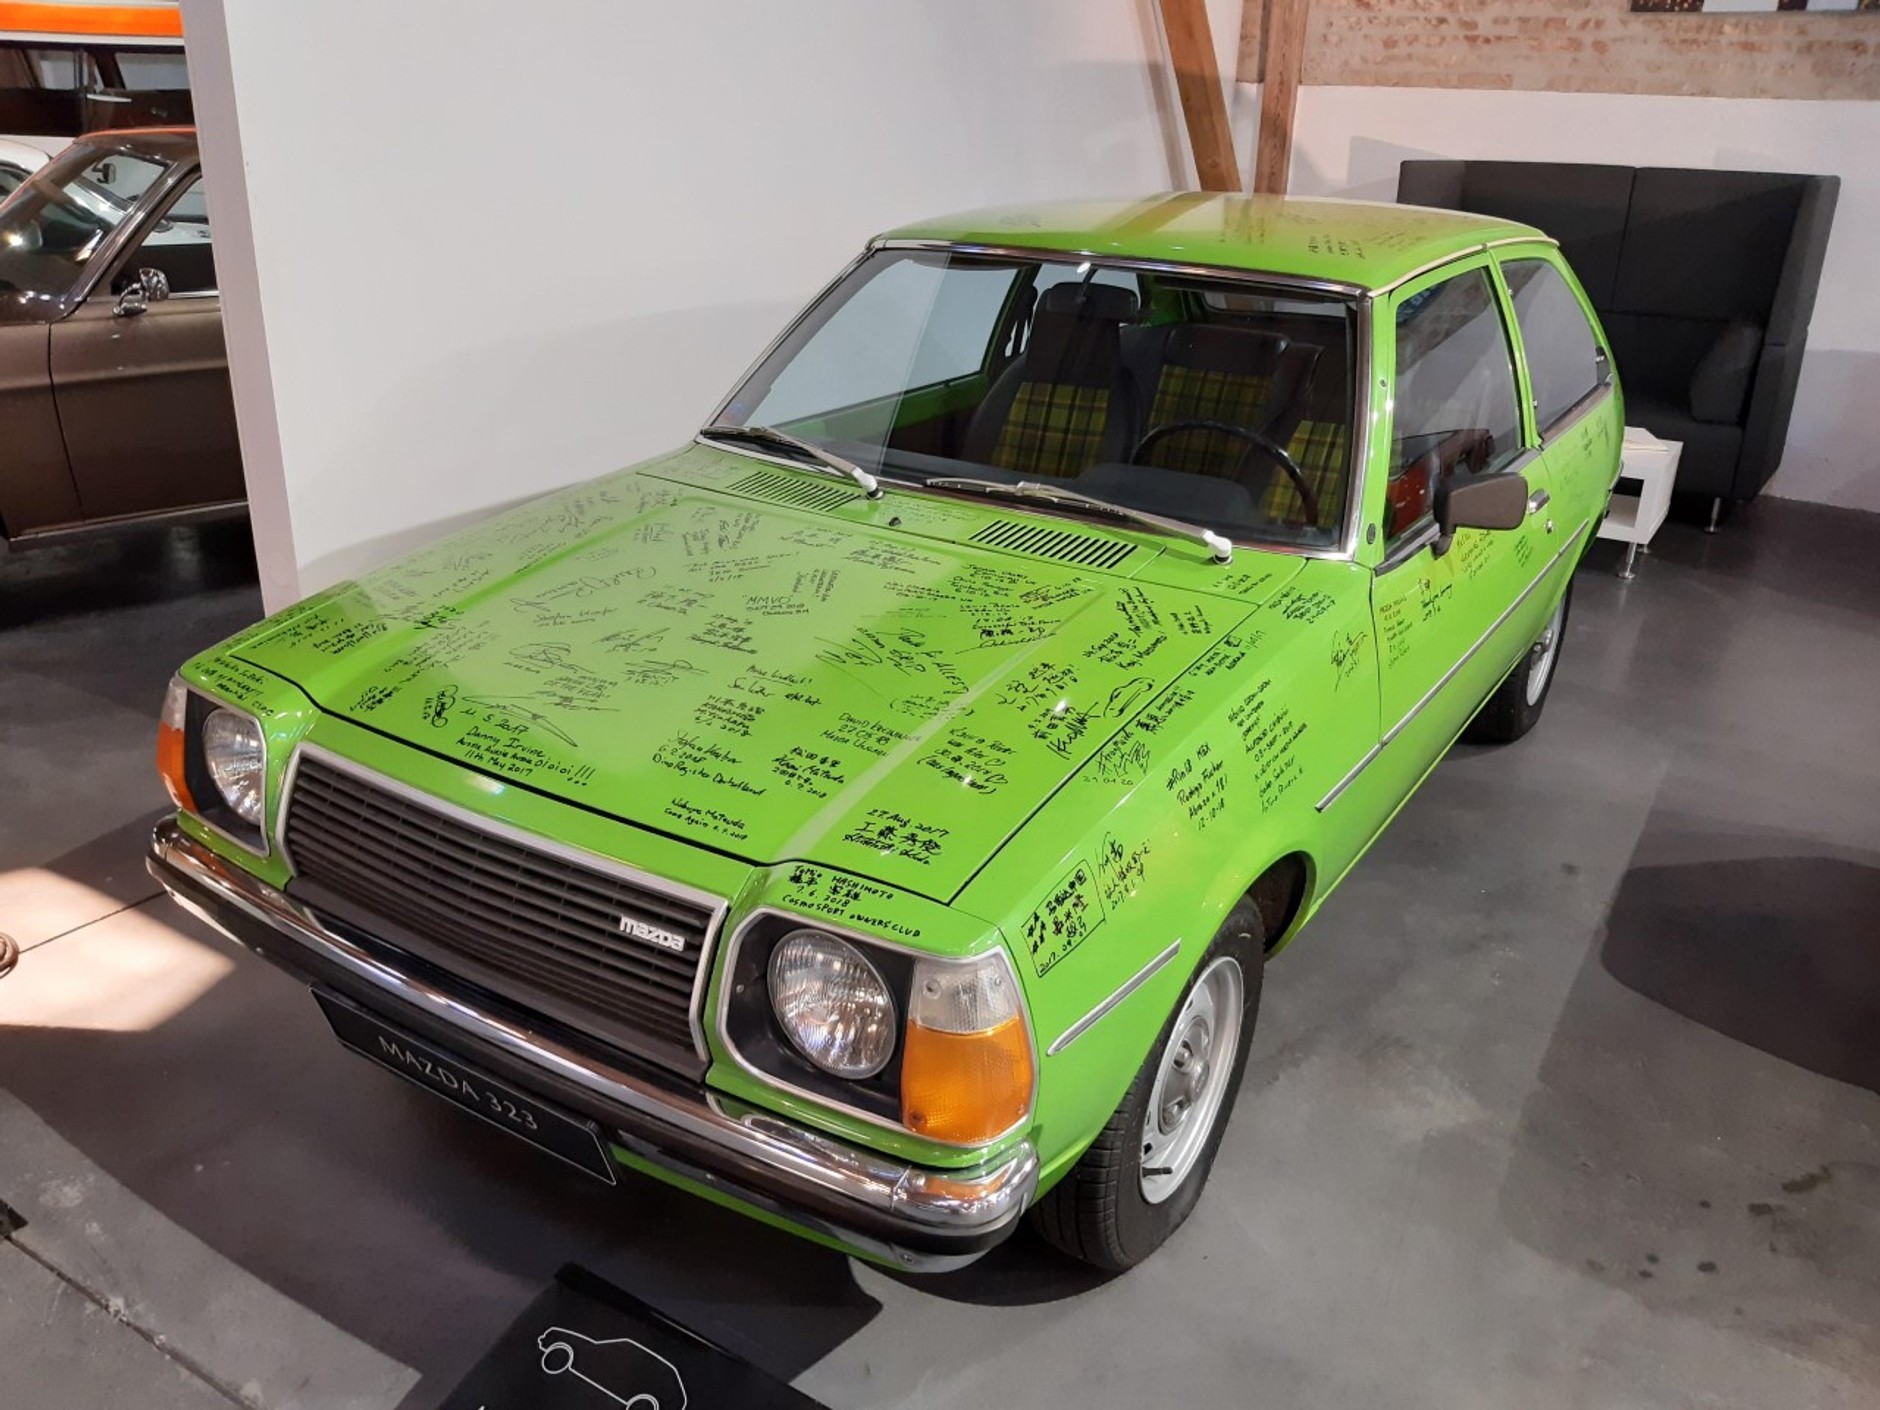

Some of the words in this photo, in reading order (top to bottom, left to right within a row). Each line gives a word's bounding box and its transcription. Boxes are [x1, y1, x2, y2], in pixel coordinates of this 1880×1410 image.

[466, 725, 501, 746] Danny
[503, 737, 546, 759] Irvine
[487, 755, 506, 771] May
[507, 762, 534, 777] 2017
[866, 809, 886, 820] 27
[914, 823, 950, 839] 2017
[823, 895, 851, 908] 2018
[831, 875, 894, 900] HASHIMOTO
[816, 902, 846, 917] SPORT
[848, 913, 891, 929] OWNERS
[891, 923, 921, 938] CLUB
[378, 1035, 480, 1101] MAZDA
[485, 1090, 538, 1130] 323
